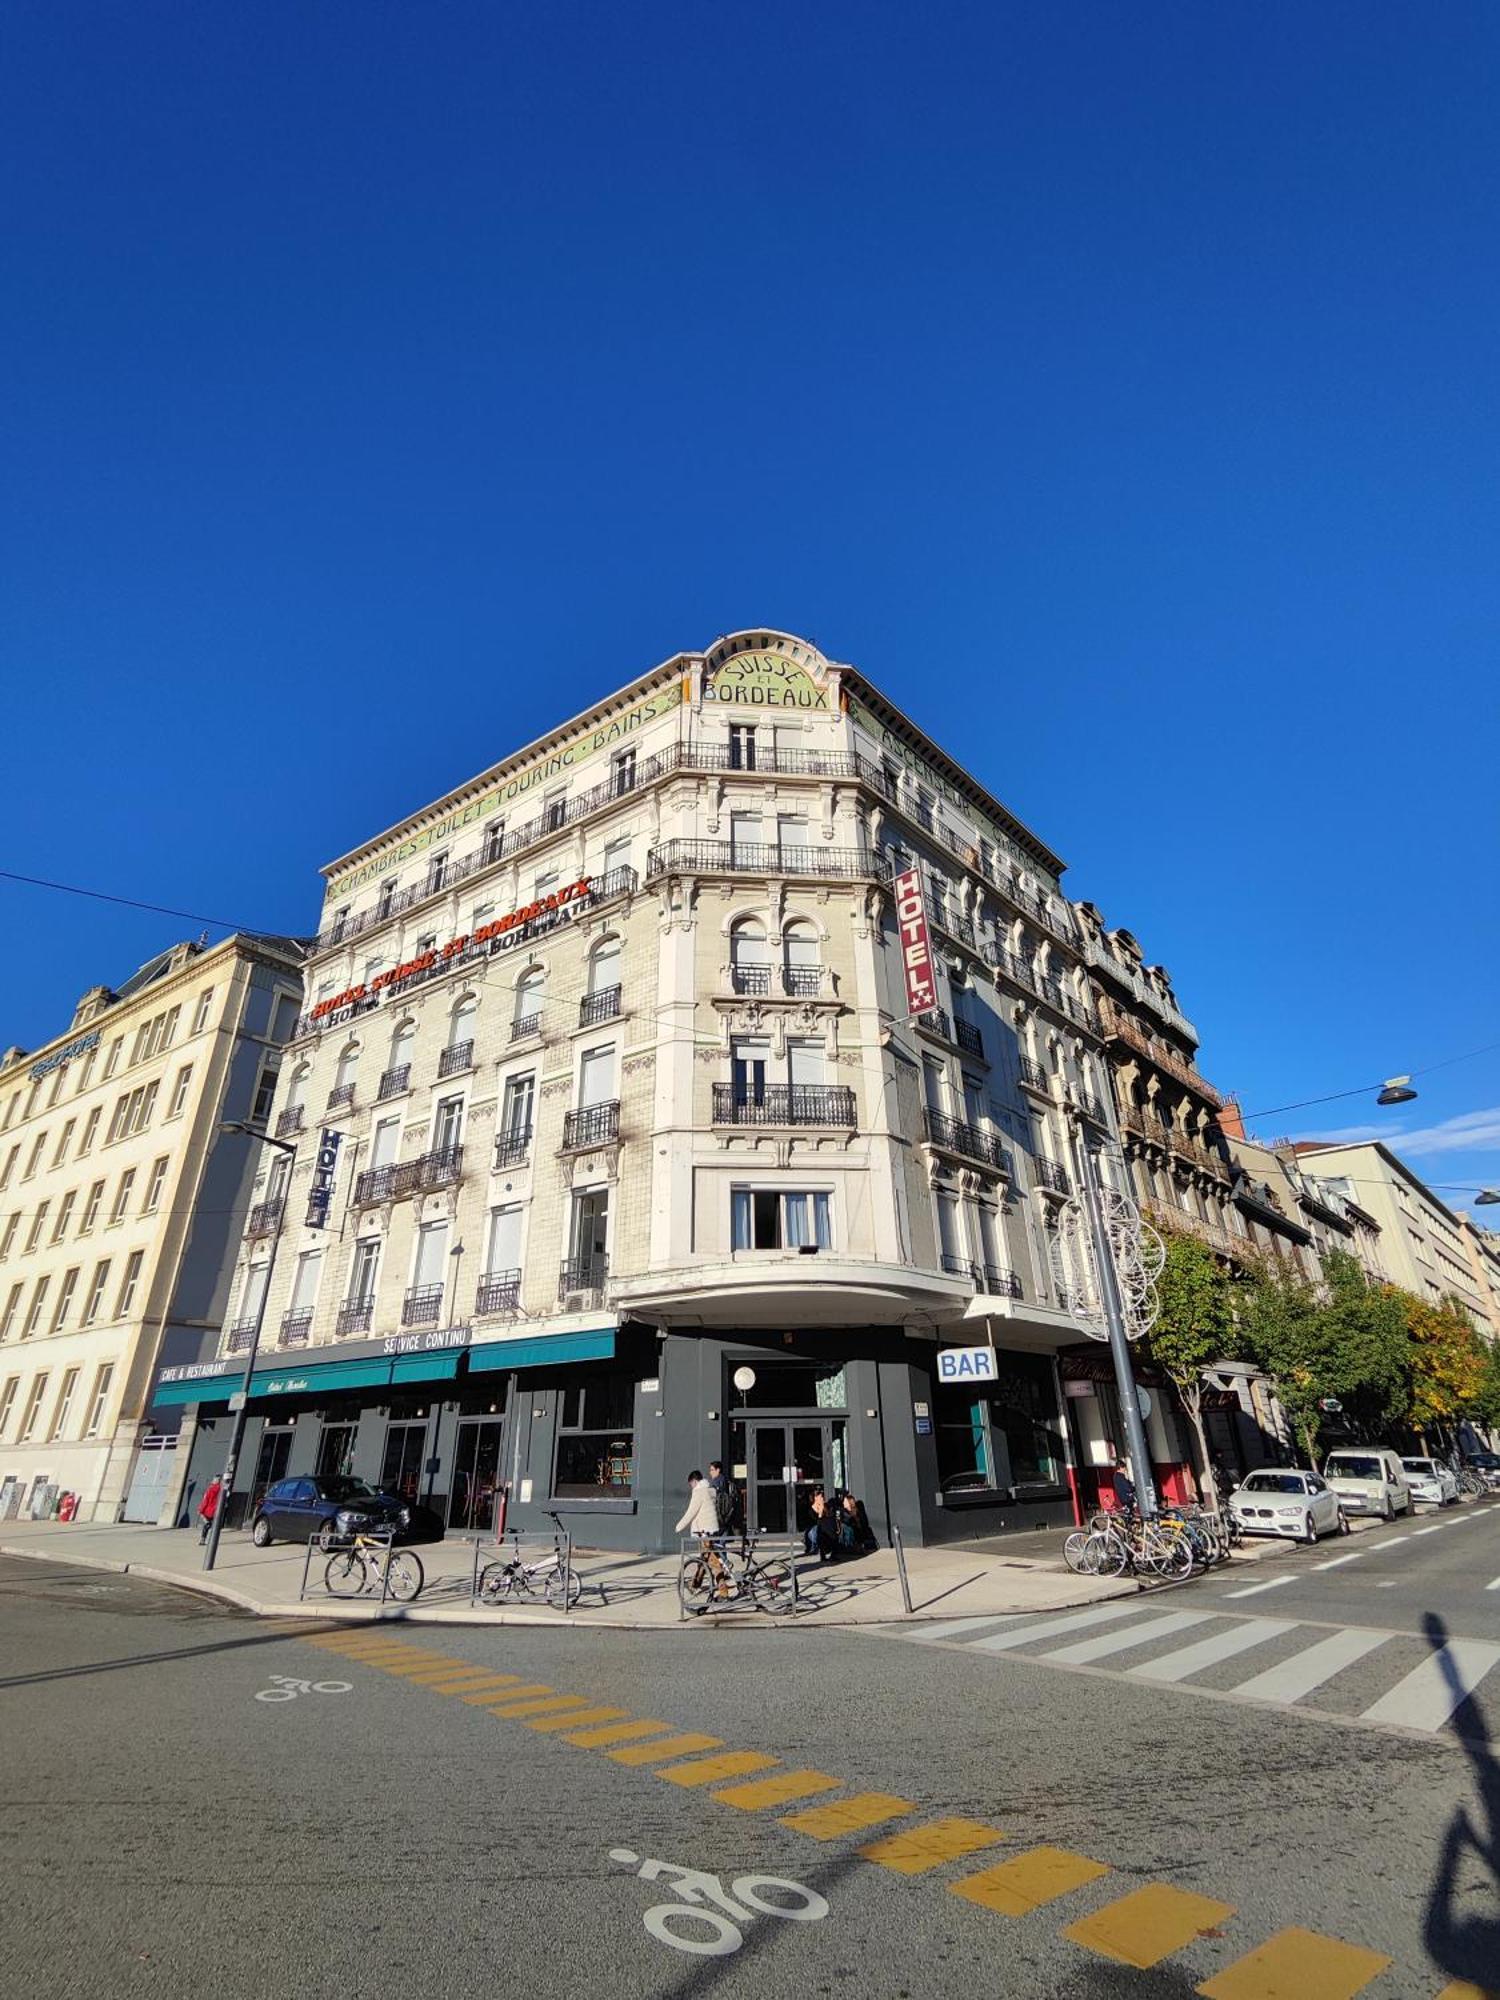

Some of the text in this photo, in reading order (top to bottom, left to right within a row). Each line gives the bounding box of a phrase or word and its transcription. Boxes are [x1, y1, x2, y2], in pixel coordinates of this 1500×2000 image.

[725, 656, 805, 684] SUISSE
[704, 683, 827, 708] BORDEAUX
[340, 701, 657, 893] CHAMBRES TOILET TOURING BAINS
[897, 872, 929, 993] HOTEL
[310, 876, 592, 1021] HOTEL SUISSE ET BORDEAUX
[426, 1329, 466, 1348] CONTINU
[186, 1362, 227, 1377] RESTAURANT
[941, 1353, 990, 1376] BAR
